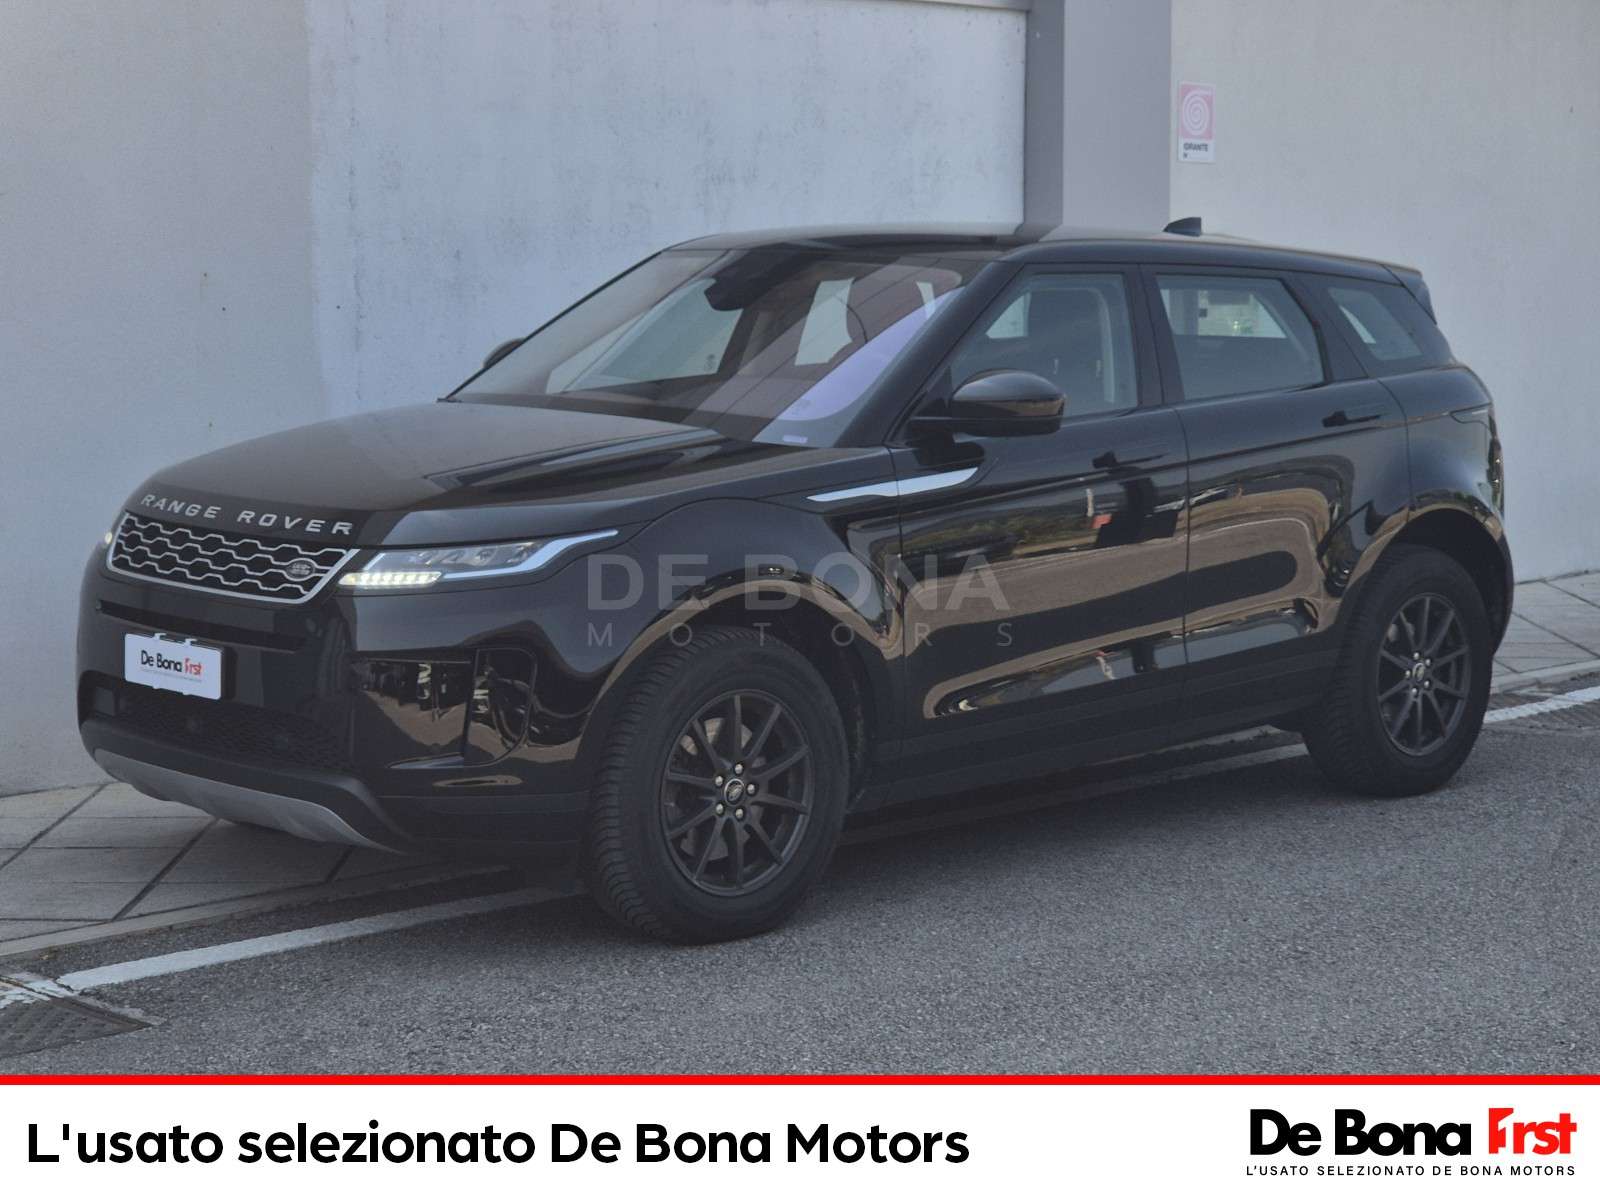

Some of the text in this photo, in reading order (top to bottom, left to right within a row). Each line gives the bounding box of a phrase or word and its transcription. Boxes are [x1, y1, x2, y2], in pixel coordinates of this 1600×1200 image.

[141, 494, 353, 535] RANGE ROVER
[141, 649, 154, 666] De
[156, 653, 182, 672] Bona
